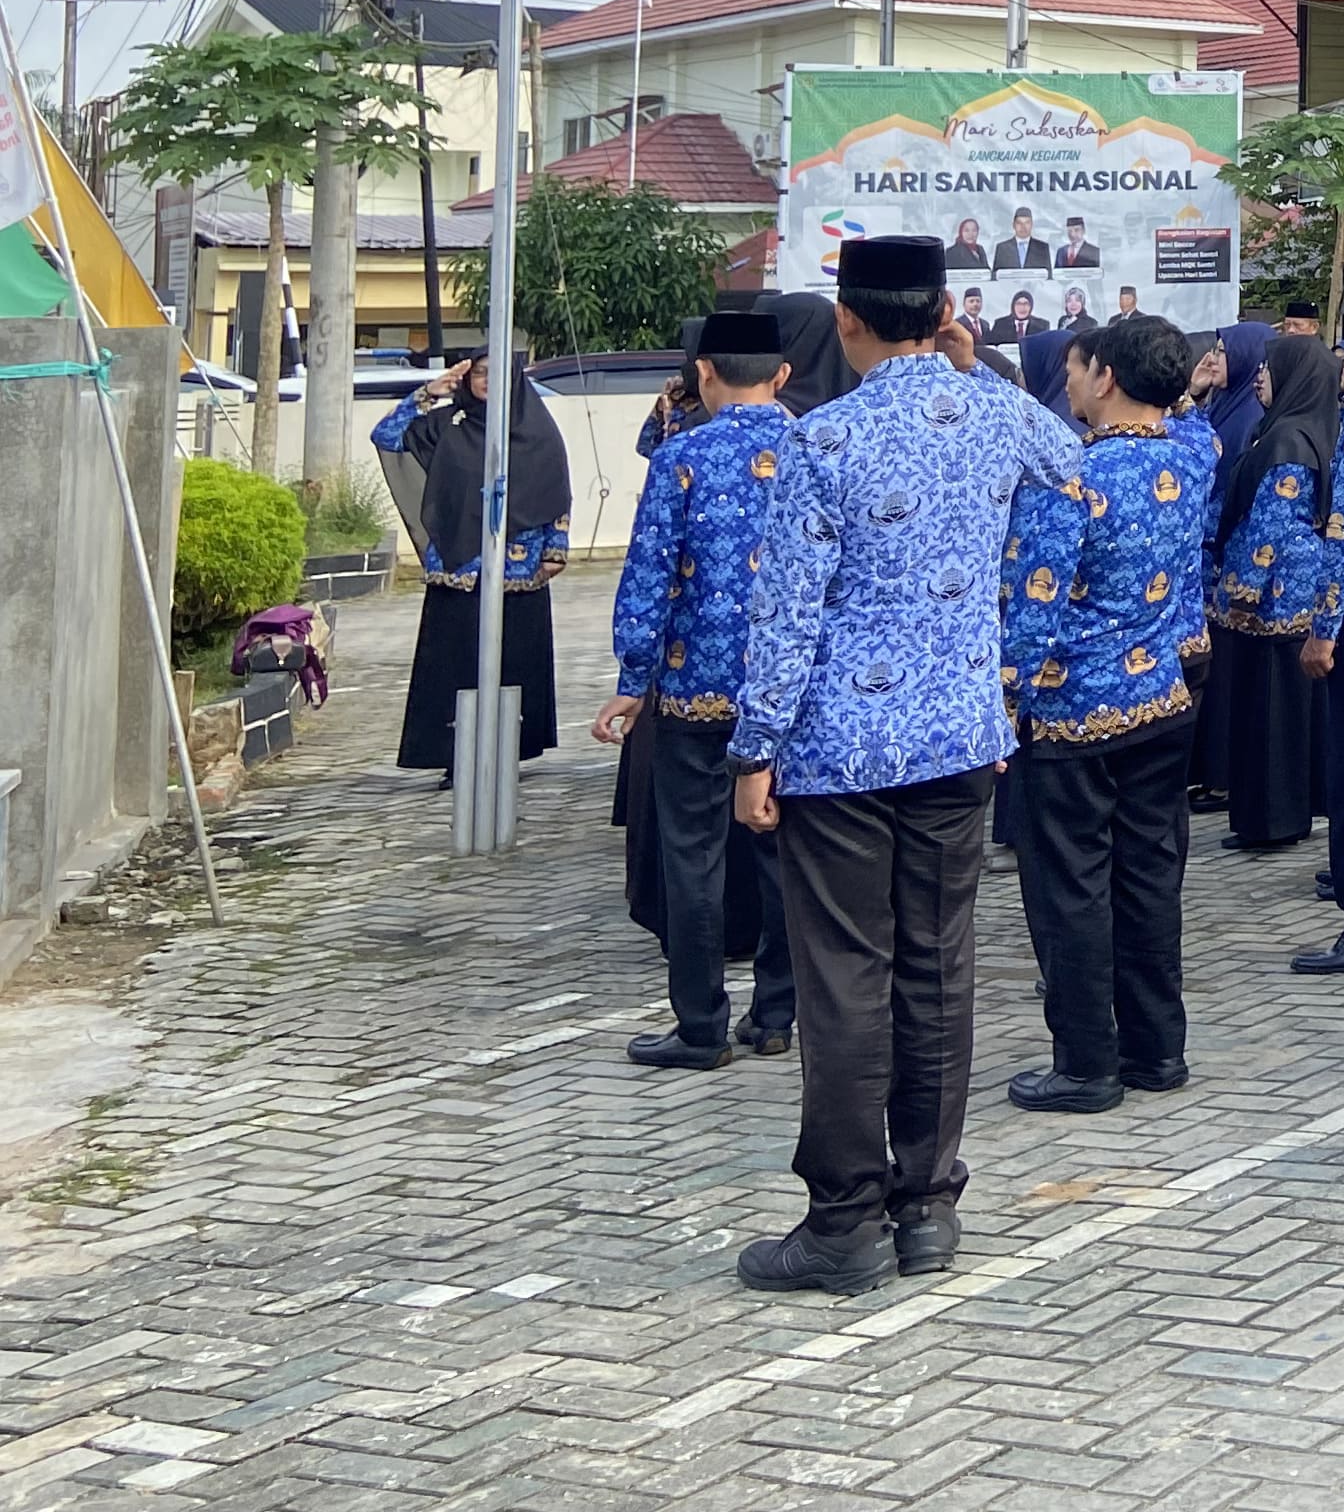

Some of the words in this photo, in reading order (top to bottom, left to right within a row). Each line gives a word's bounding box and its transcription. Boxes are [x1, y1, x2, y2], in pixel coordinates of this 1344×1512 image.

[941, 115, 998, 143] Mari
[1005, 110, 1113, 142] Sukseskan
[967, 149, 1029, 162] RANGKAIAN
[1030, 148, 1082, 162] KEGIATAN
[854, 171, 928, 193] HARI
[934, 170, 1044, 193] SANTRI
[1049, 169, 1198, 192] NASIONAL
